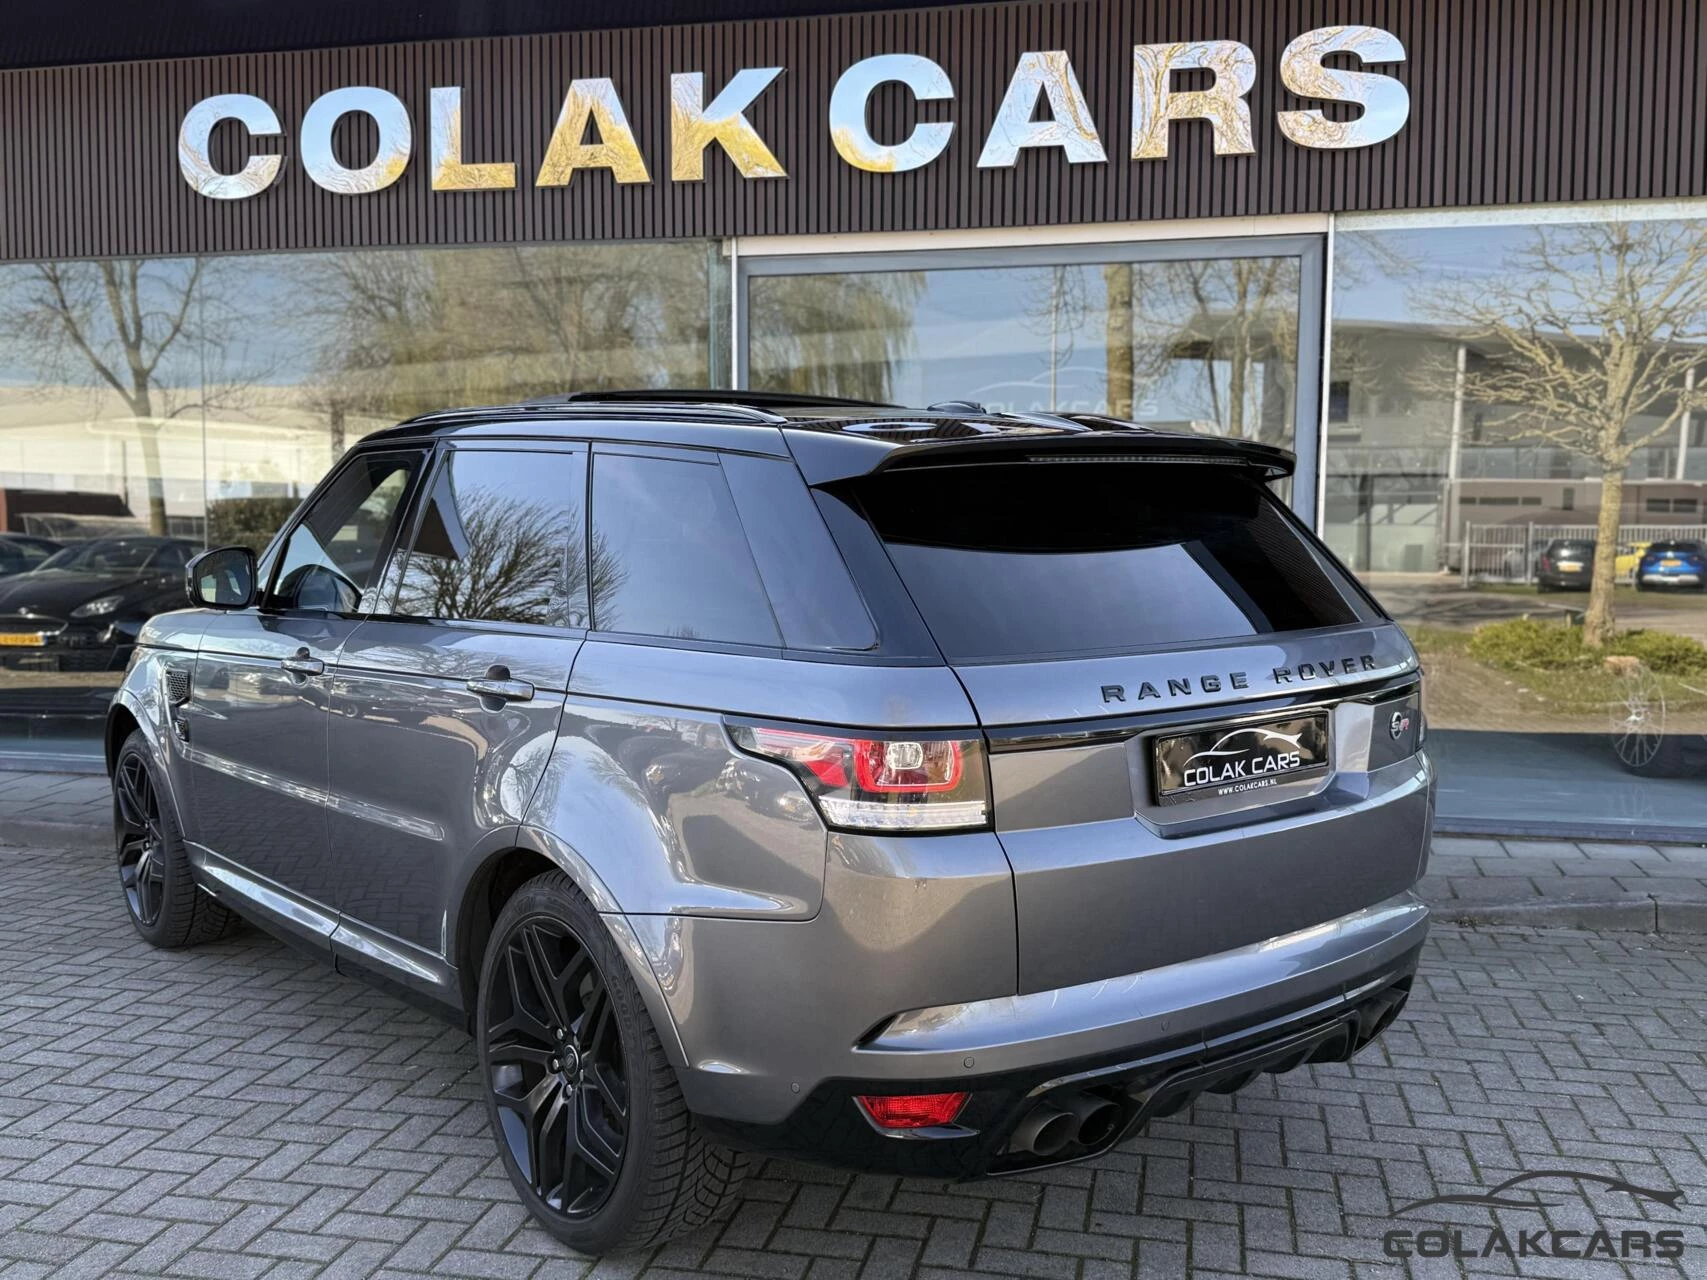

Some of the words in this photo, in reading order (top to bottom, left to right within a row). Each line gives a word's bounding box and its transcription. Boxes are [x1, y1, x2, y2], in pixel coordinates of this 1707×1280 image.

[177, 66, 789, 201] COLAK
[828, 24, 1411, 174] CARS
[984, 400, 1160, 416] OLAKCARS
[1101, 671, 1250, 703] RANGE
[1273, 654, 1376, 684] ROVER
[1183, 760, 1246, 787] COLAK
[1252, 751, 1300, 773] CARS
[1217, 779, 1278, 795] WWW.COLAKCARS.NL
